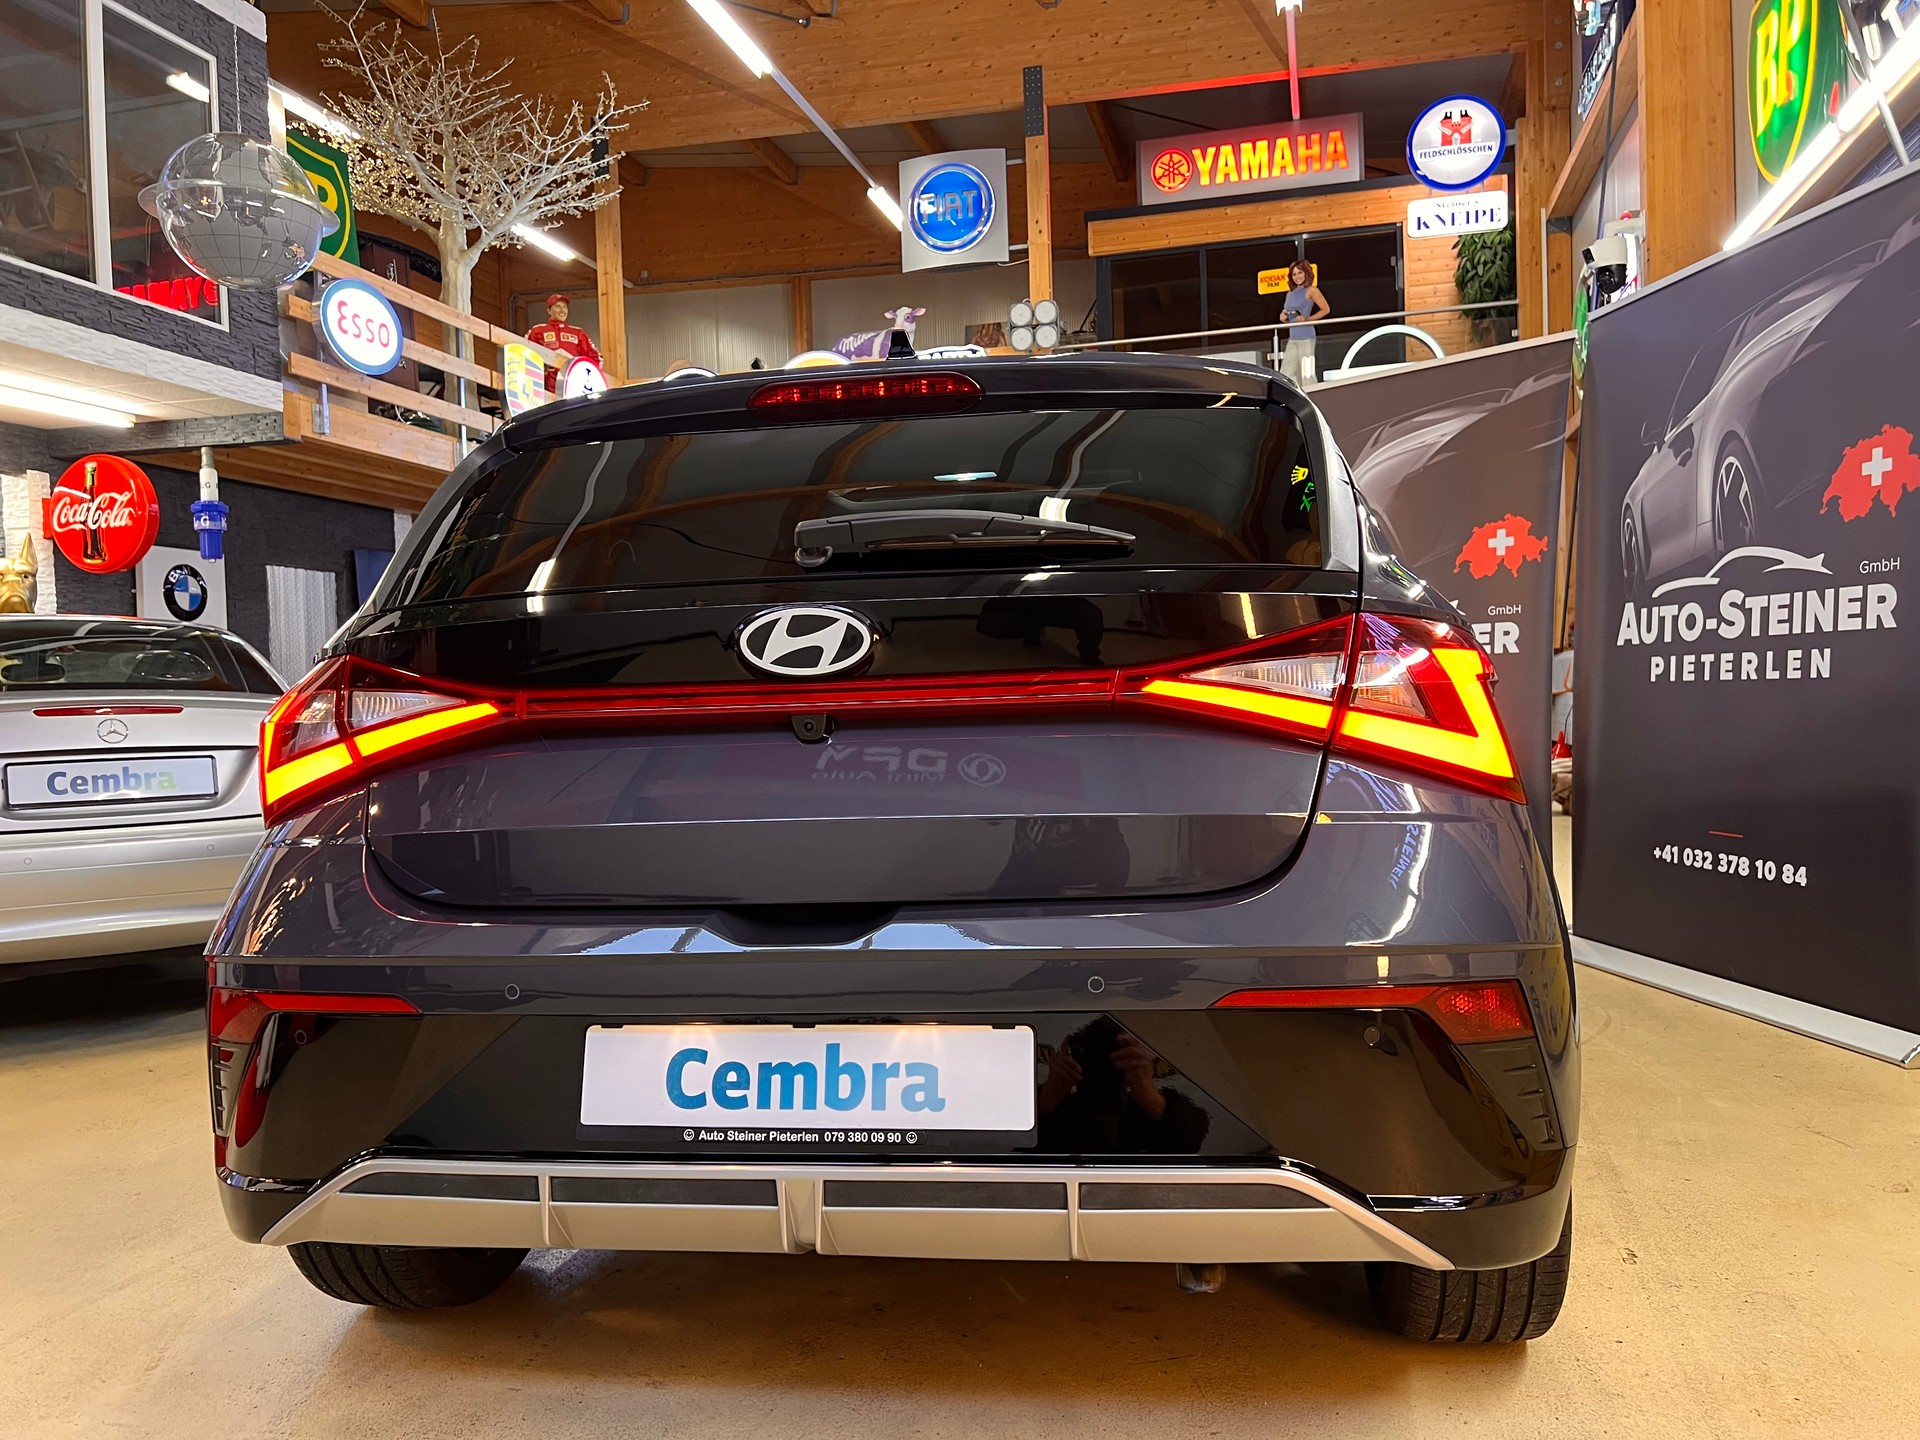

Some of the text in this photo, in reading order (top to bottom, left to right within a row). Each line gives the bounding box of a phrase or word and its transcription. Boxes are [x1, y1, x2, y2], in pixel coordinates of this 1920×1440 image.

[1756, 0, 1807, 137] BP
[1192, 130, 1349, 187] YAMAHA
[1419, 145, 1493, 159] FELDSCHLÖSSCHEN
[919, 190, 978, 224] FIAT
[1416, 208, 1501, 231] KNEIPE
[1259, 274, 1286, 284] KODAK
[53, 490, 136, 532] Coca-Cola
[1859, 556, 1900, 574] GmbH
[1487, 604, 1522, 616] GmbH
[1616, 583, 1898, 646] AUTO-STEINER
[1650, 648, 1831, 682] PIETERLEN
[46, 766, 178, 796] Cembra
[1653, 844, 1808, 887] +41 032 378 10 84
[666, 1043, 946, 1113] Cembra
[699, 1130, 902, 1143] Auto Steiner Pieterlen 079 380 09 90
